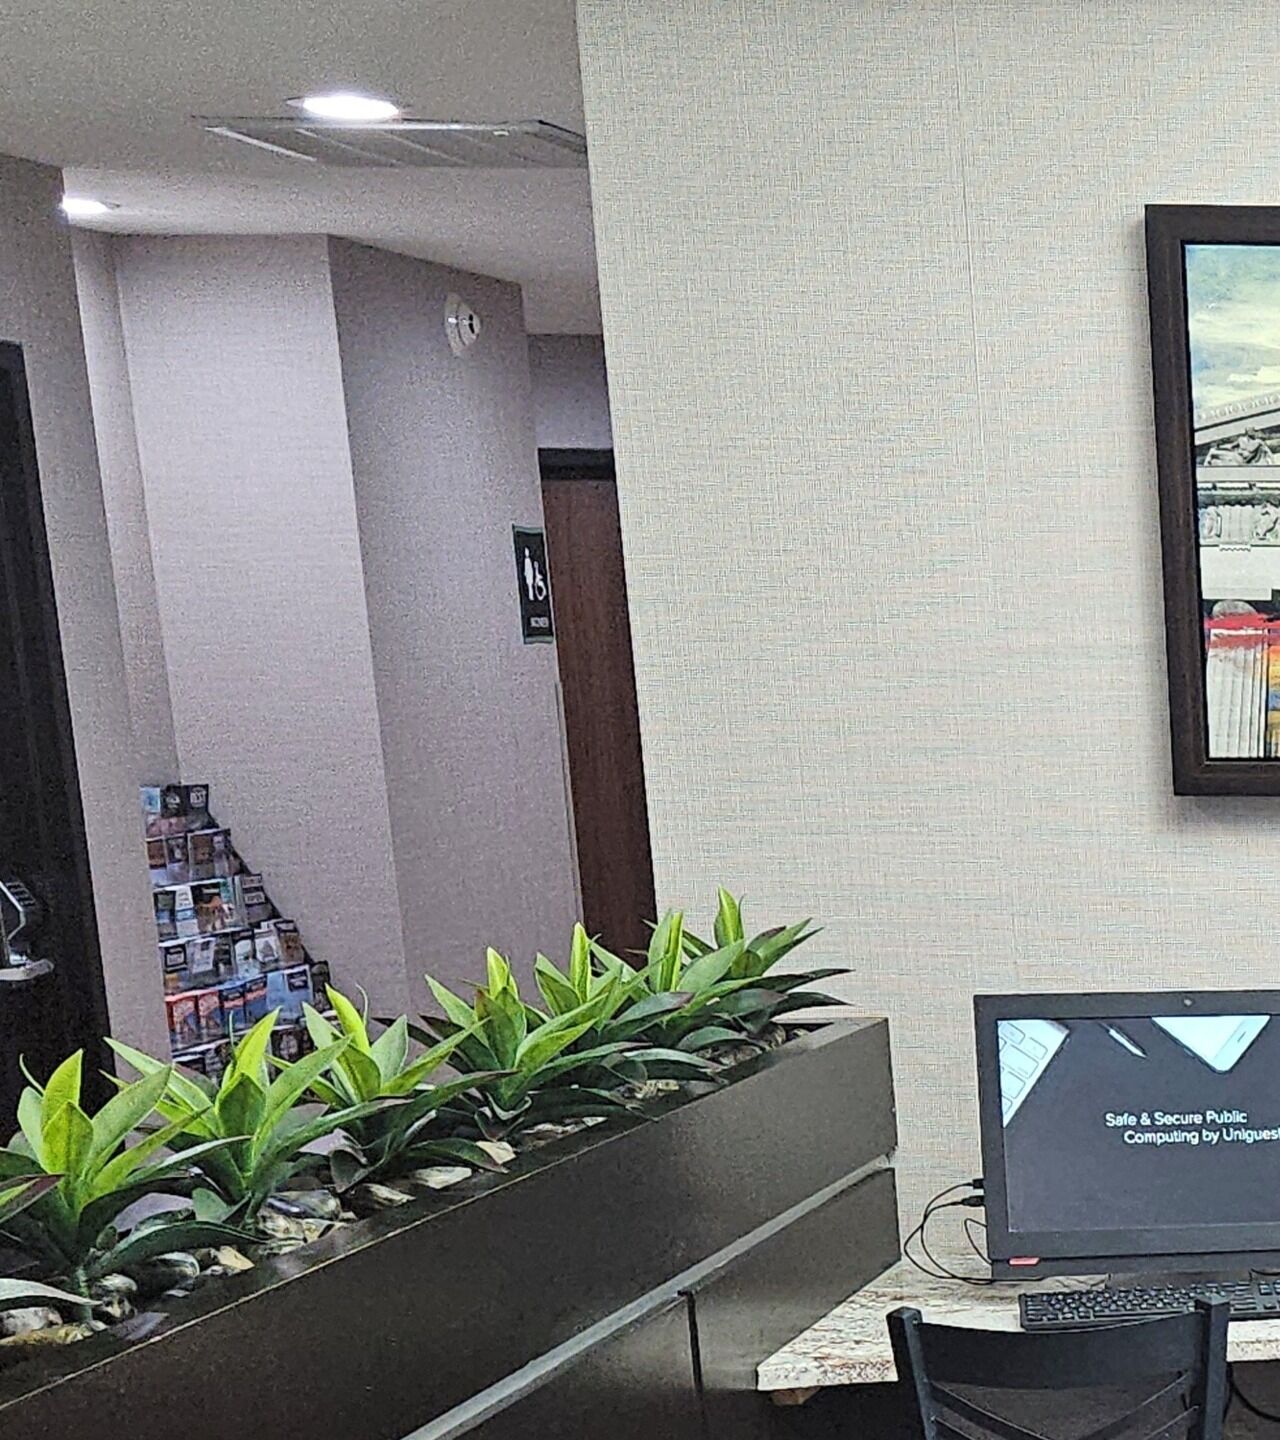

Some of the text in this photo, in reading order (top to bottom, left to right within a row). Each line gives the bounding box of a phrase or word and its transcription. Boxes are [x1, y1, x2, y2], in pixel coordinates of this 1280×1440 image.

[1105, 1110, 1248, 1127] Safe & Secure Public
[1123, 1129, 1199, 1146] Computing
[1202, 1129, 1219, 1145] by
